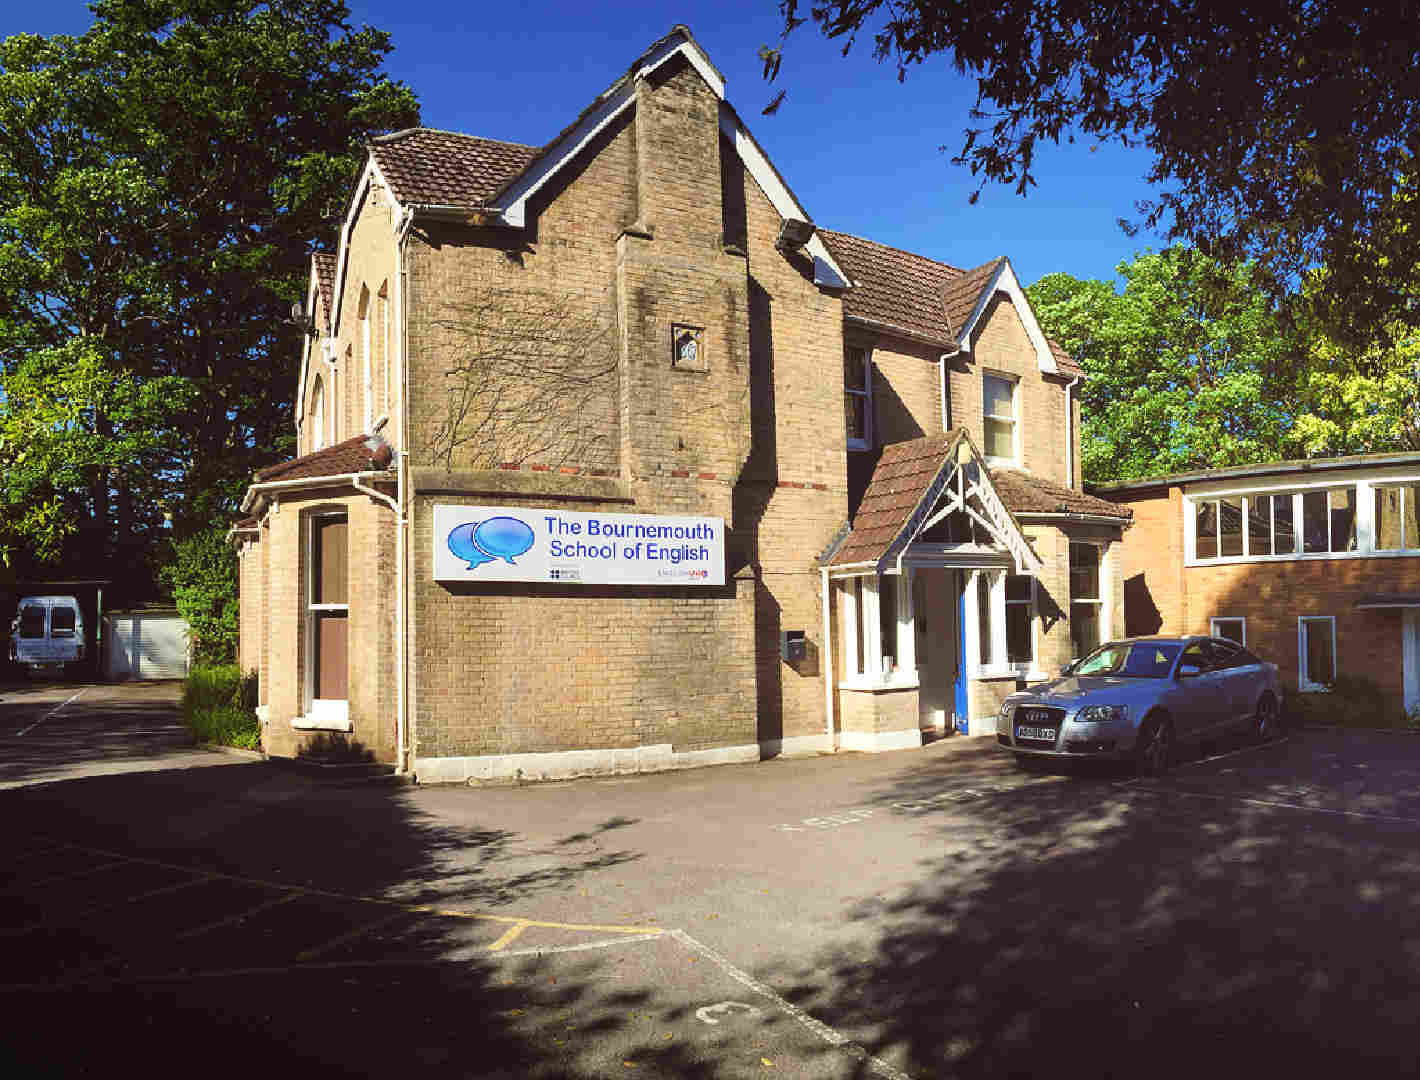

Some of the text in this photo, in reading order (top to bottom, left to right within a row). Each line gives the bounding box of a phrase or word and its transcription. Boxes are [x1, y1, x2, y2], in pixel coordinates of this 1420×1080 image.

[544, 516, 714, 540] The Bournemouth
[551, 540, 709, 565] School of English
